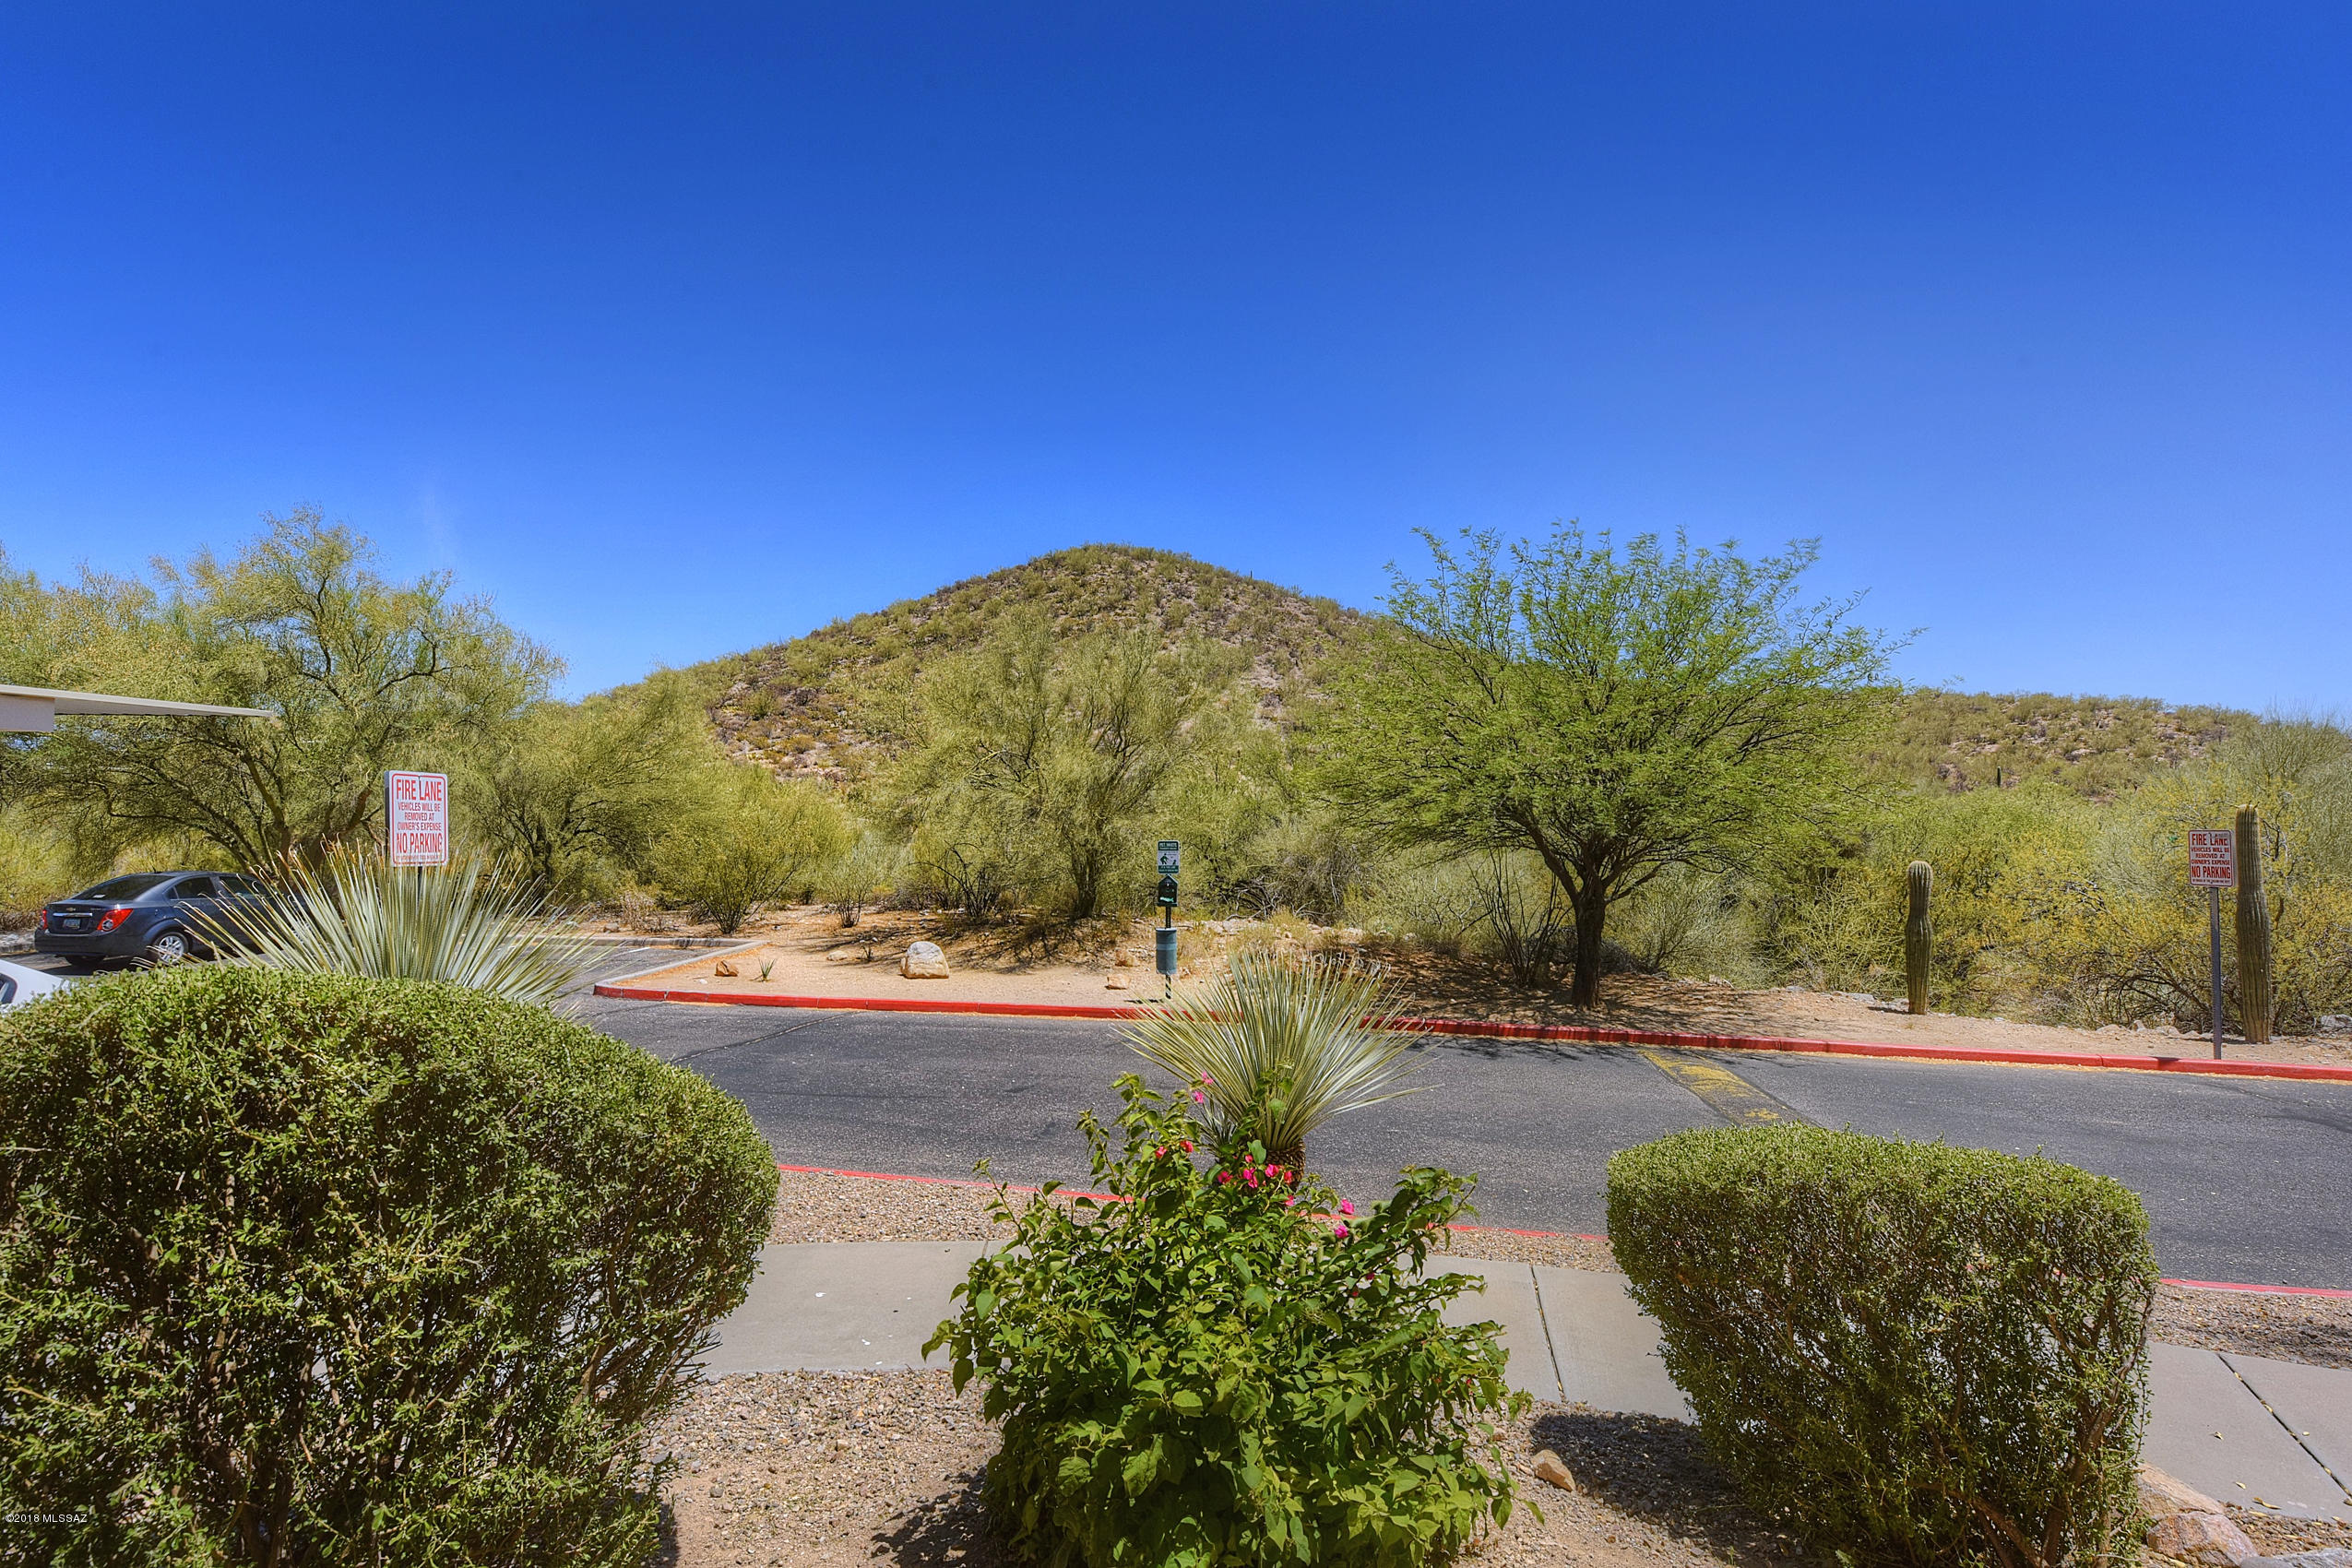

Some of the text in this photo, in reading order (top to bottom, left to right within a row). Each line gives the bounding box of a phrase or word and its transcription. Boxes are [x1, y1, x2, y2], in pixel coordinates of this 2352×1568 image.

[397, 778, 442, 802] FIRE LANE
[398, 802, 441, 812] VEHICLES WILL BE
[405, 813, 434, 821] REMOVED AT
[398, 822, 442, 831] OWNER'S EXPENSE
[397, 832, 443, 853] NO PARKING
[2192, 833, 2228, 846] FIRE LANE
[2192, 865, 2230, 878] NO PARKING
